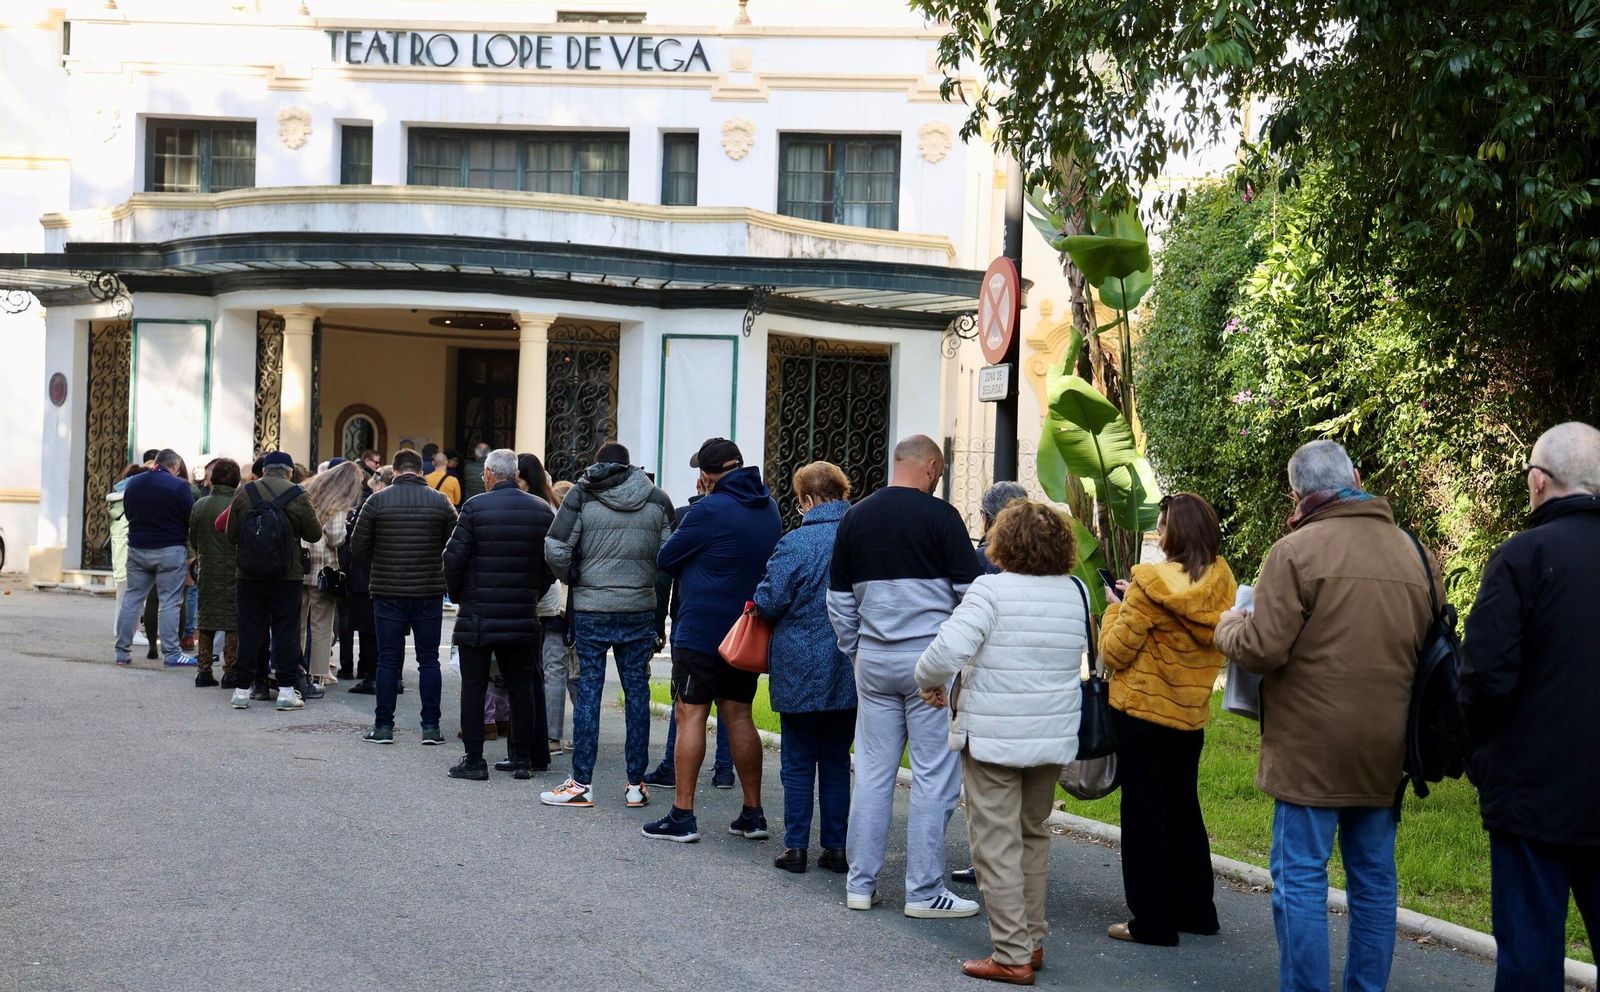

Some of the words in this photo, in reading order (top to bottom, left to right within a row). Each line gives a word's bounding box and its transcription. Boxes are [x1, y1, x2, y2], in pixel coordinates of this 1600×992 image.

[324, 30, 458, 67] TEATRO
[472, 33, 552, 68] LOPE
[566, 36, 602, 70] DE
[609, 36, 711, 72] VEGA
